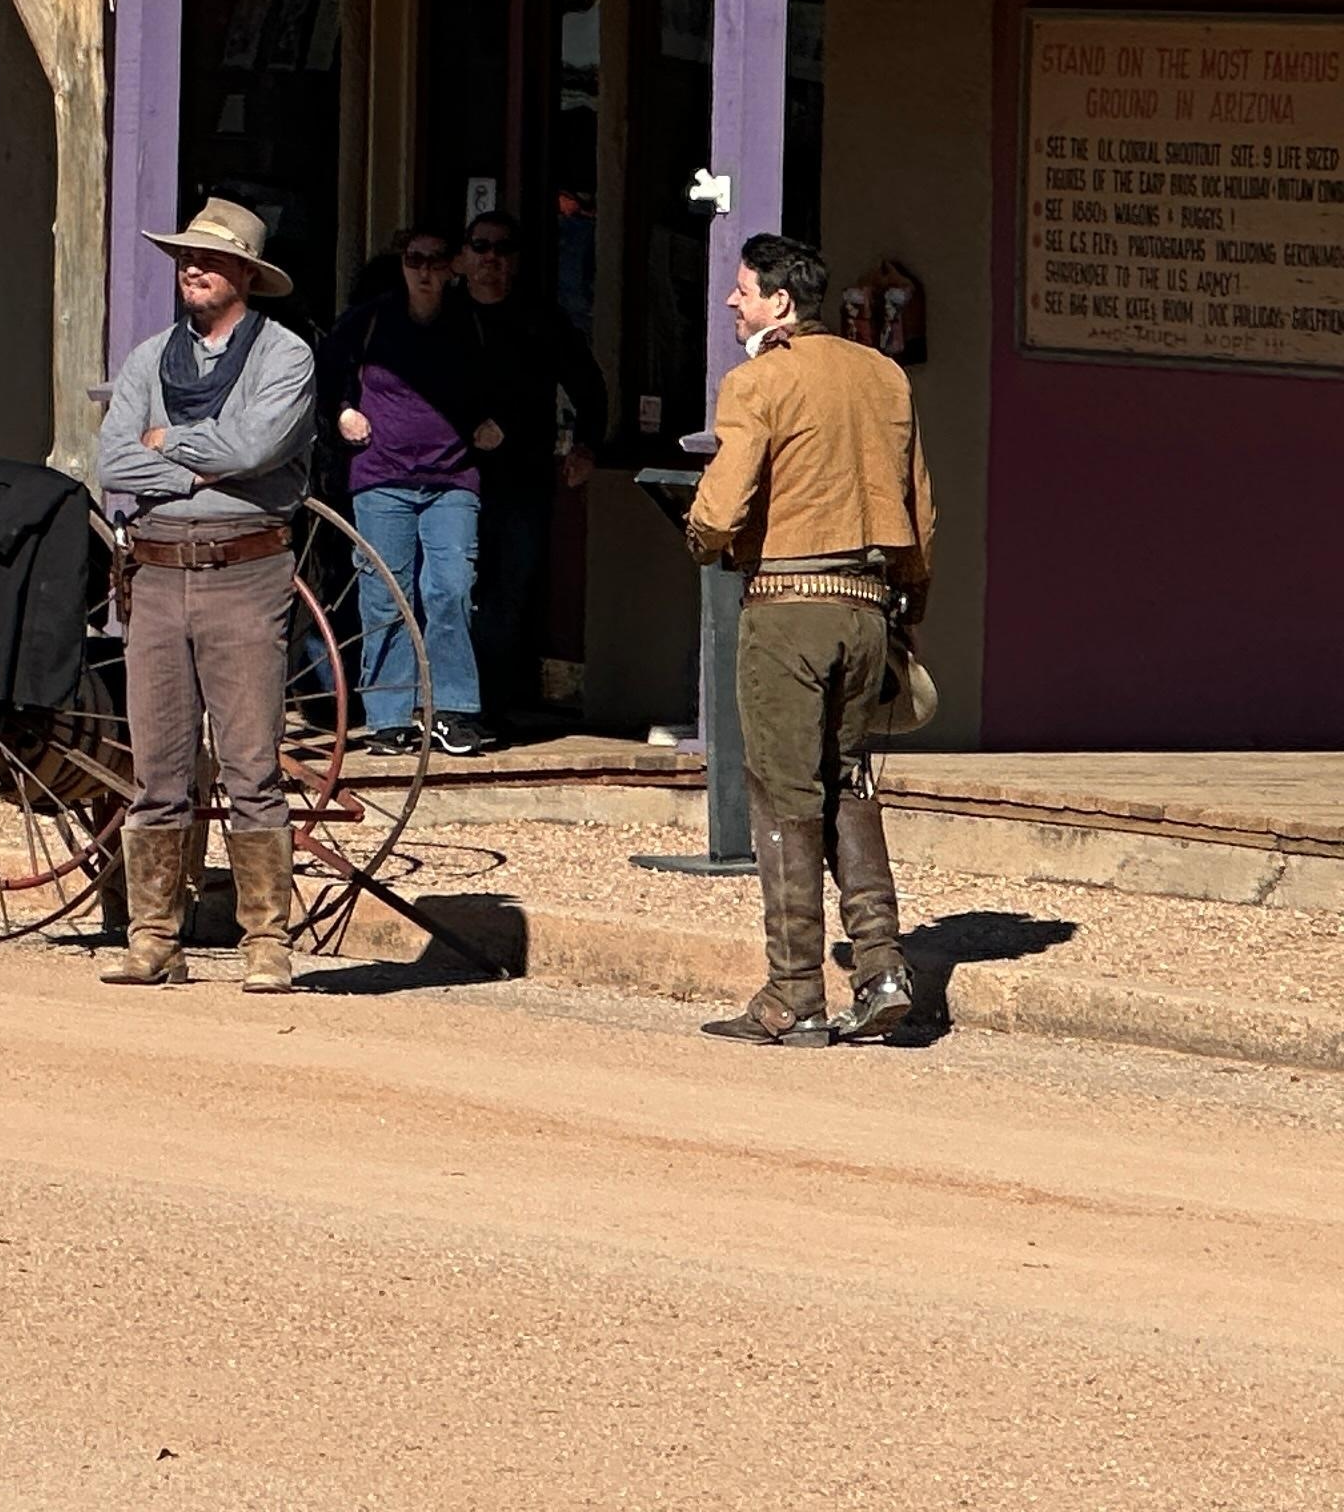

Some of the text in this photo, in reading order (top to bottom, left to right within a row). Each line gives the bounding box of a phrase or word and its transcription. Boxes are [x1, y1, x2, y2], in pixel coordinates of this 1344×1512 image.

[1042, 44, 1339, 83] STAND ON THE MOST FAMOUS
[1086, 88, 1296, 125] GROUND IN ARIZONA
[1046, 136, 1067, 159] SEE
[1071, 137, 1088, 161] THE
[1120, 139, 1160, 164] CORRAL
[1166, 142, 1221, 167] SHOOTOUT
[1264, 145, 1272, 169] 9
[1278, 146, 1301, 170] LIFE
[1306, 147, 1340, 171] SIZED
[1047, 167, 1086, 191] FIGURES
[1093, 169, 1105, 192] OF
[1113, 169, 1133, 194] THE
[1140, 171, 1165, 195] EARP
[1202, 175, 1221, 199] DOC
[1045, 198, 1064, 221] SEE
[1114, 203, 1160, 227] WAGONS
[1045, 229, 1064, 253] SEE
[1128, 235, 1206, 262] PHOTOGRAPHS
[1215, 240, 1277, 265] INCLUDING
[1045, 260, 1109, 287] SURRENDER
[1115, 265, 1130, 289] TO
[1137, 267, 1159, 290] THE
[1045, 291, 1065, 315] SEE
[1070, 293, 1088, 318] BIG
[1092, 295, 1120, 319] NOSE
[1163, 298, 1193, 324] ROOM
